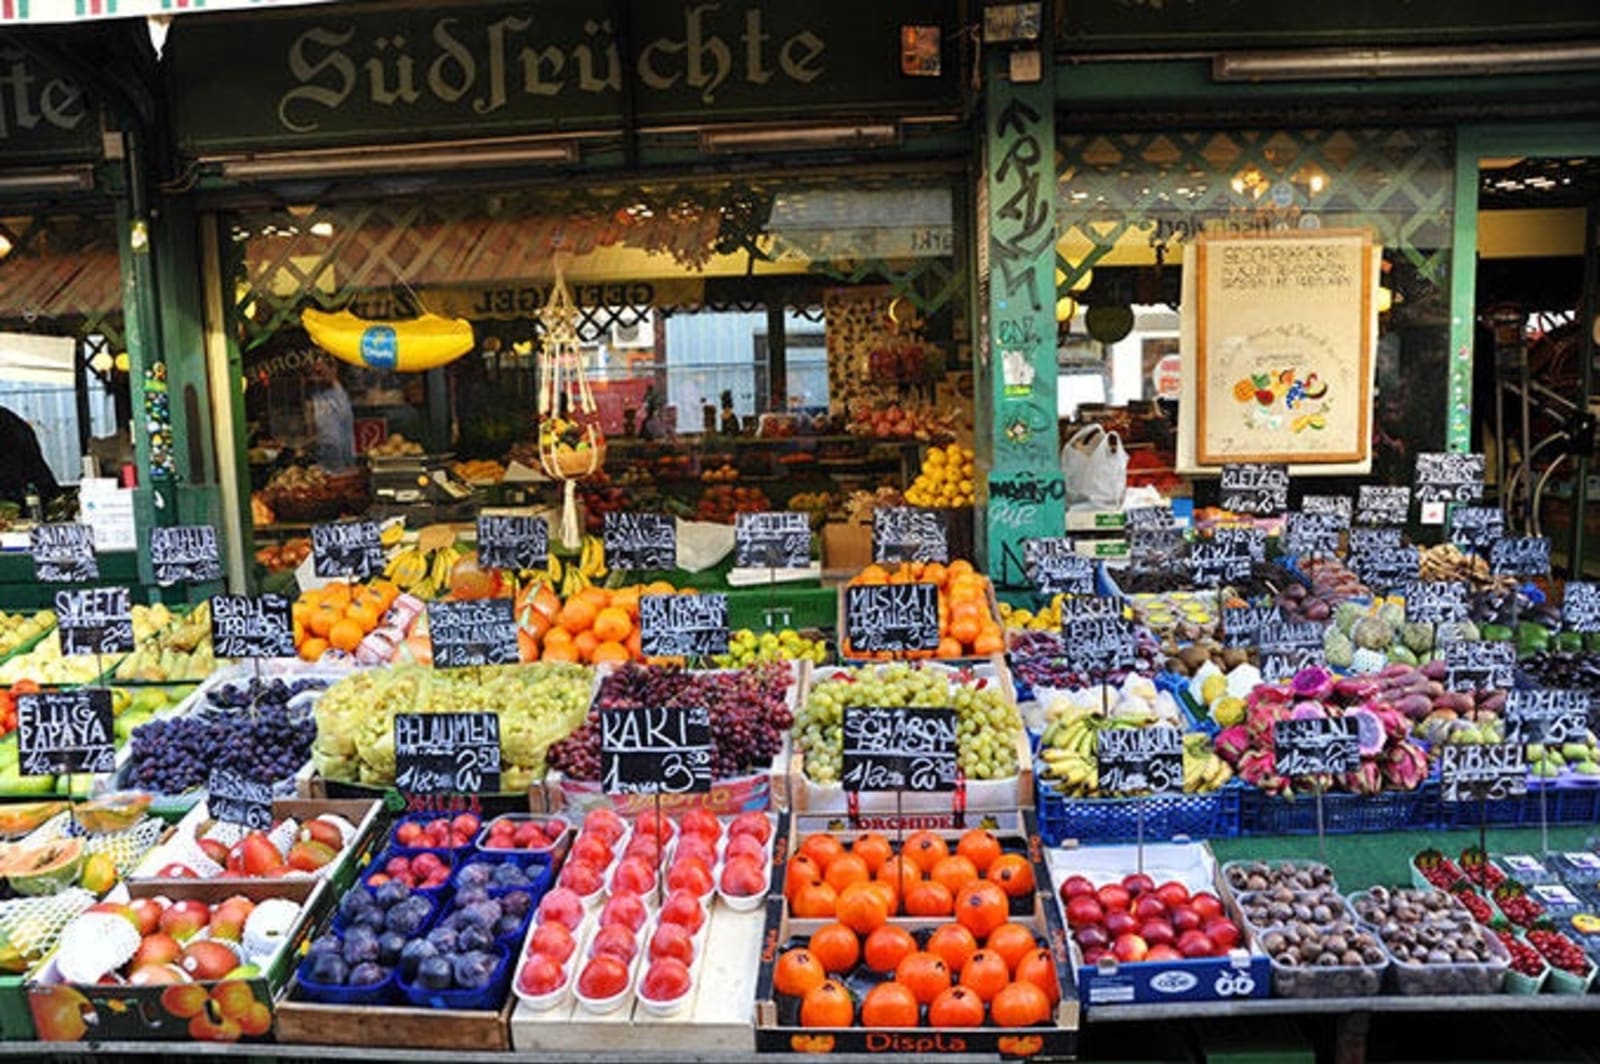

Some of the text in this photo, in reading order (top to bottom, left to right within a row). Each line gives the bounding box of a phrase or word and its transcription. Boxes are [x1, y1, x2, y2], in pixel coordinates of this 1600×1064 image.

[604, 512, 673, 529] NAVL
[850, 586, 935, 612] MUSKAT
[20, 718, 108, 751] PAPAYA
[602, 710, 688, 750] KAKI
